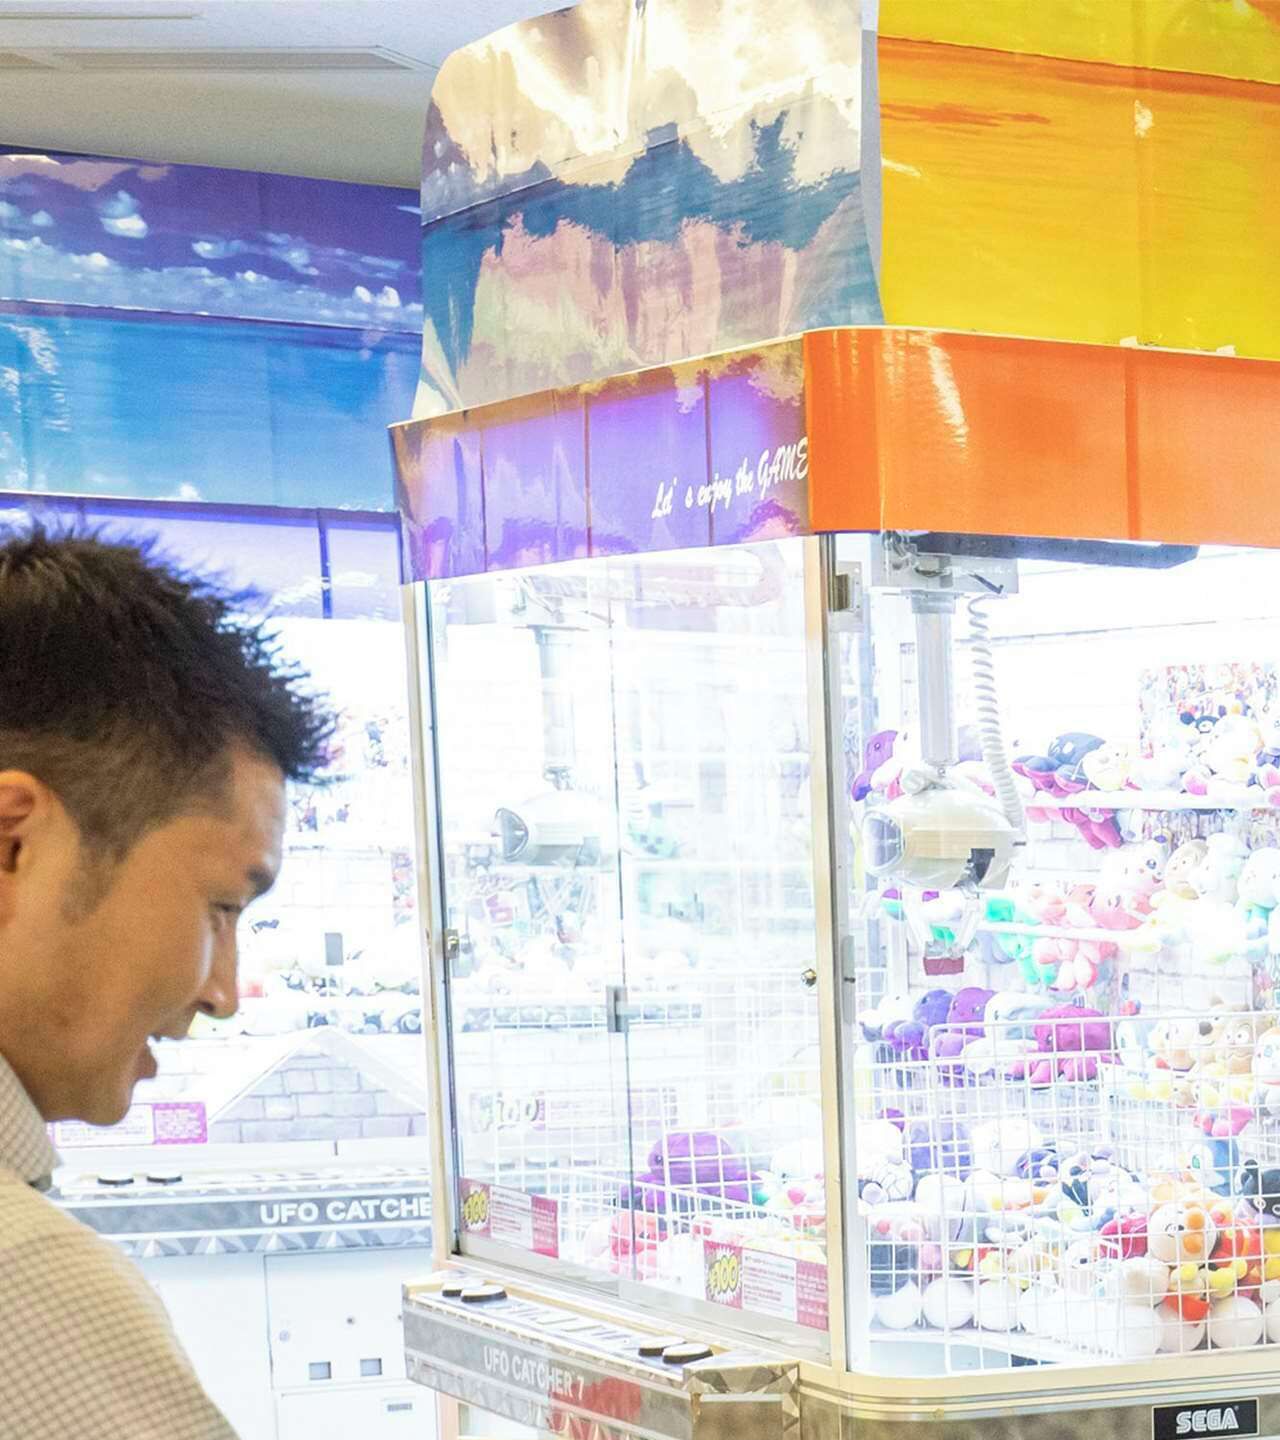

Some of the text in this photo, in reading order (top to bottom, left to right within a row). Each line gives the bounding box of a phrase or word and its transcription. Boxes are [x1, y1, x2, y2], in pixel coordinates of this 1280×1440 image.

[697, 473, 732, 513] enjoy
[736, 457, 754, 496] the
[260, 1202, 319, 1224] UFO
[483, 1345, 510, 1377] UFO
[511, 1354, 574, 1398] CATCHER
[1175, 1407, 1240, 1434] SEGA
